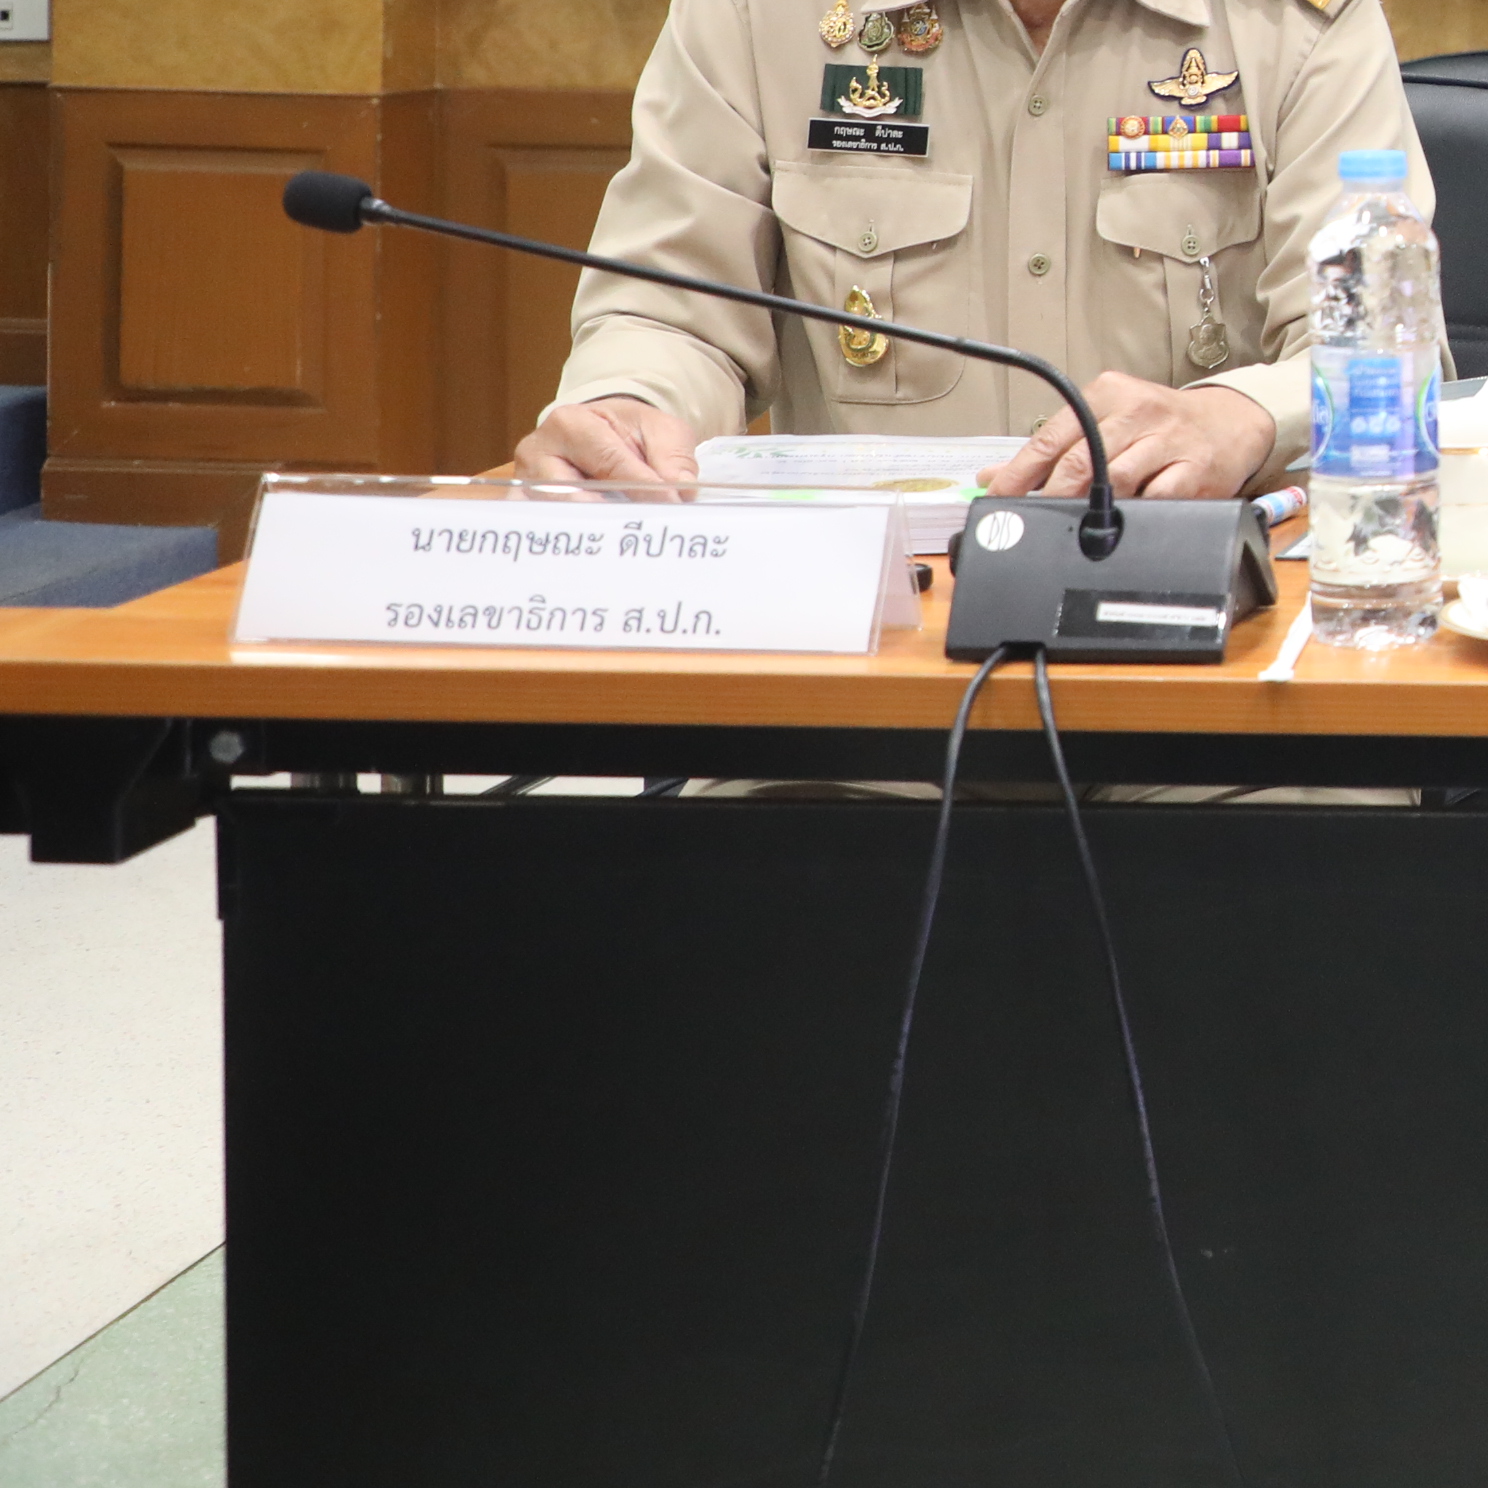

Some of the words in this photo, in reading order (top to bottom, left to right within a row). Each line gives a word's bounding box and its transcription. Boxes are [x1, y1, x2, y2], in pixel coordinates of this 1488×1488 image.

[412, 522, 604, 562] นายกฤษณะ
[618, 521, 729, 560] ดีปาละ
[386, 595, 606, 634] รองเลขาธิการ
[622, 602, 722, 636] ส.ป.ก.
